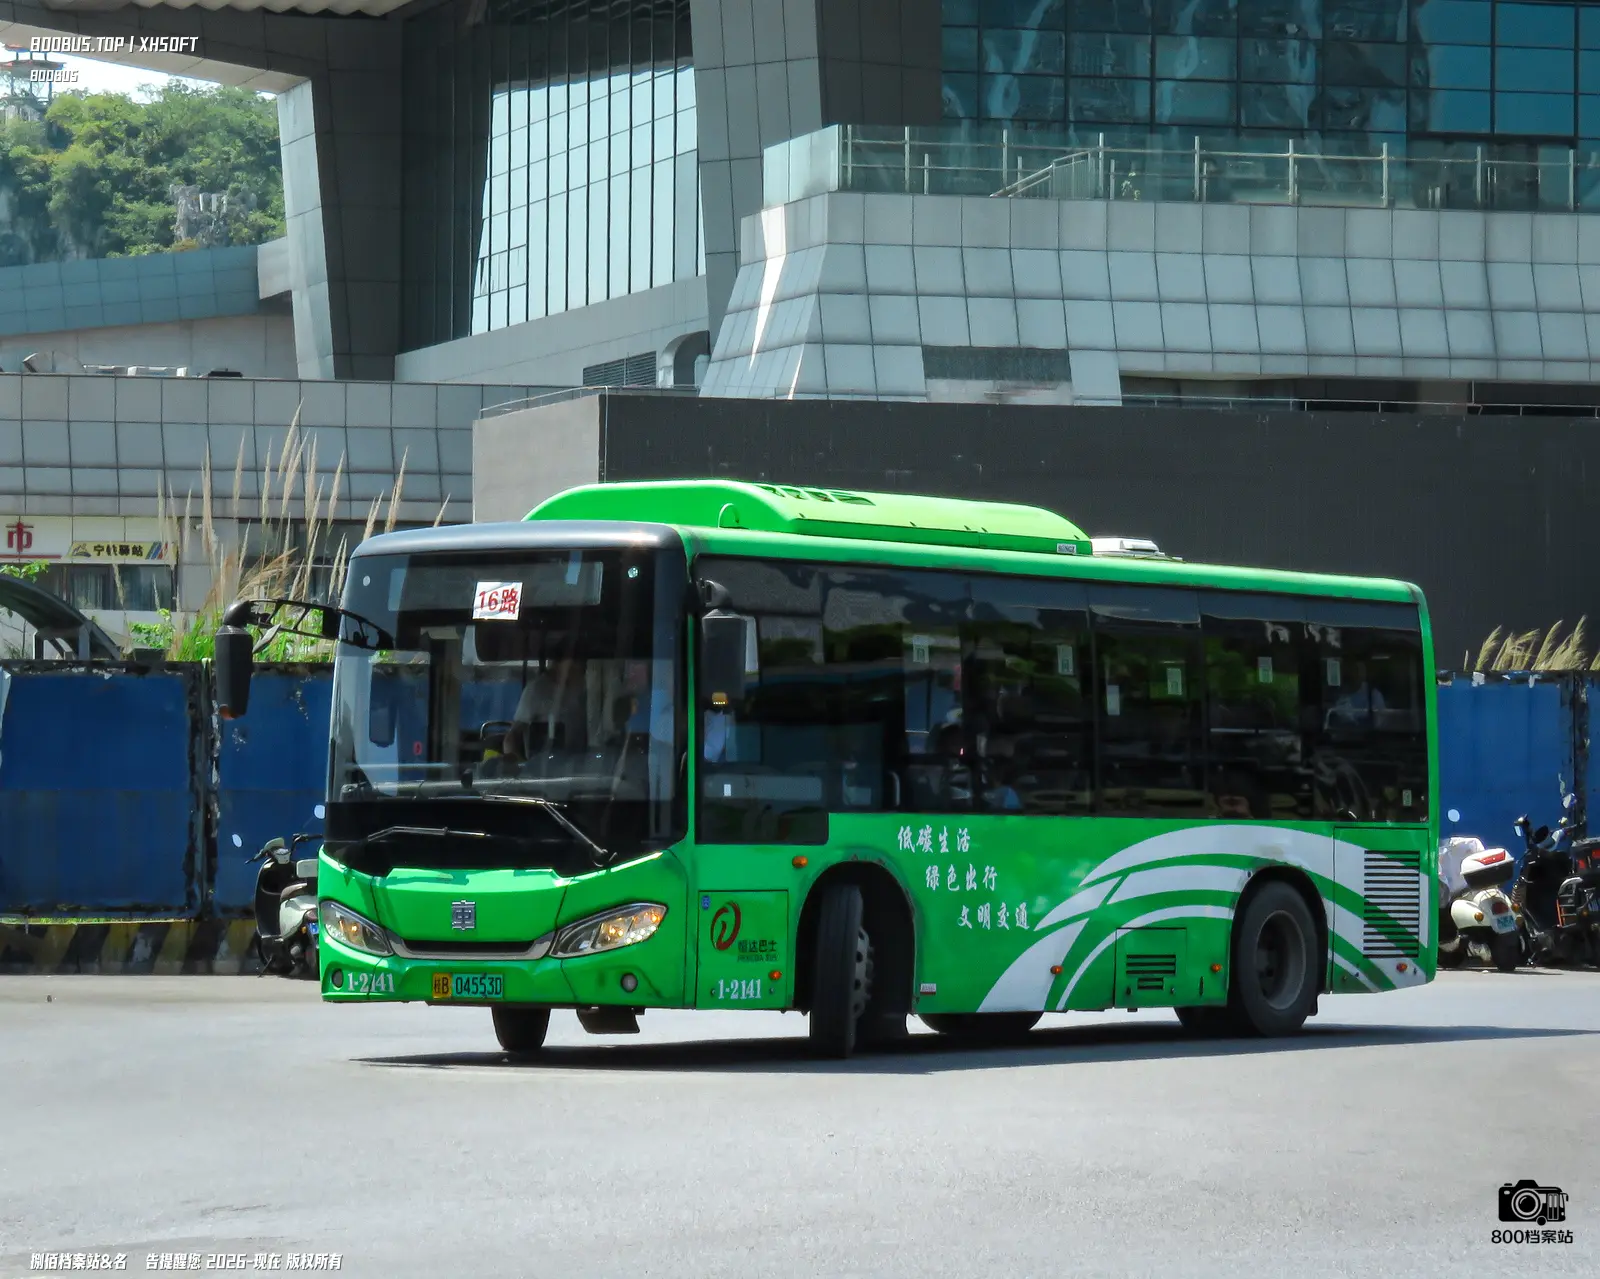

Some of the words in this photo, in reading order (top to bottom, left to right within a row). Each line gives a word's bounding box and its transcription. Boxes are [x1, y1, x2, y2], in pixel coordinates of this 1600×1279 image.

[478, 588, 518, 614] 16路
[898, 825, 971, 853] 低碳生活
[925, 863, 998, 891] 绿色出行
[957, 902, 1030, 930] 文明交通
[718, 979, 761, 999] 1-2141
